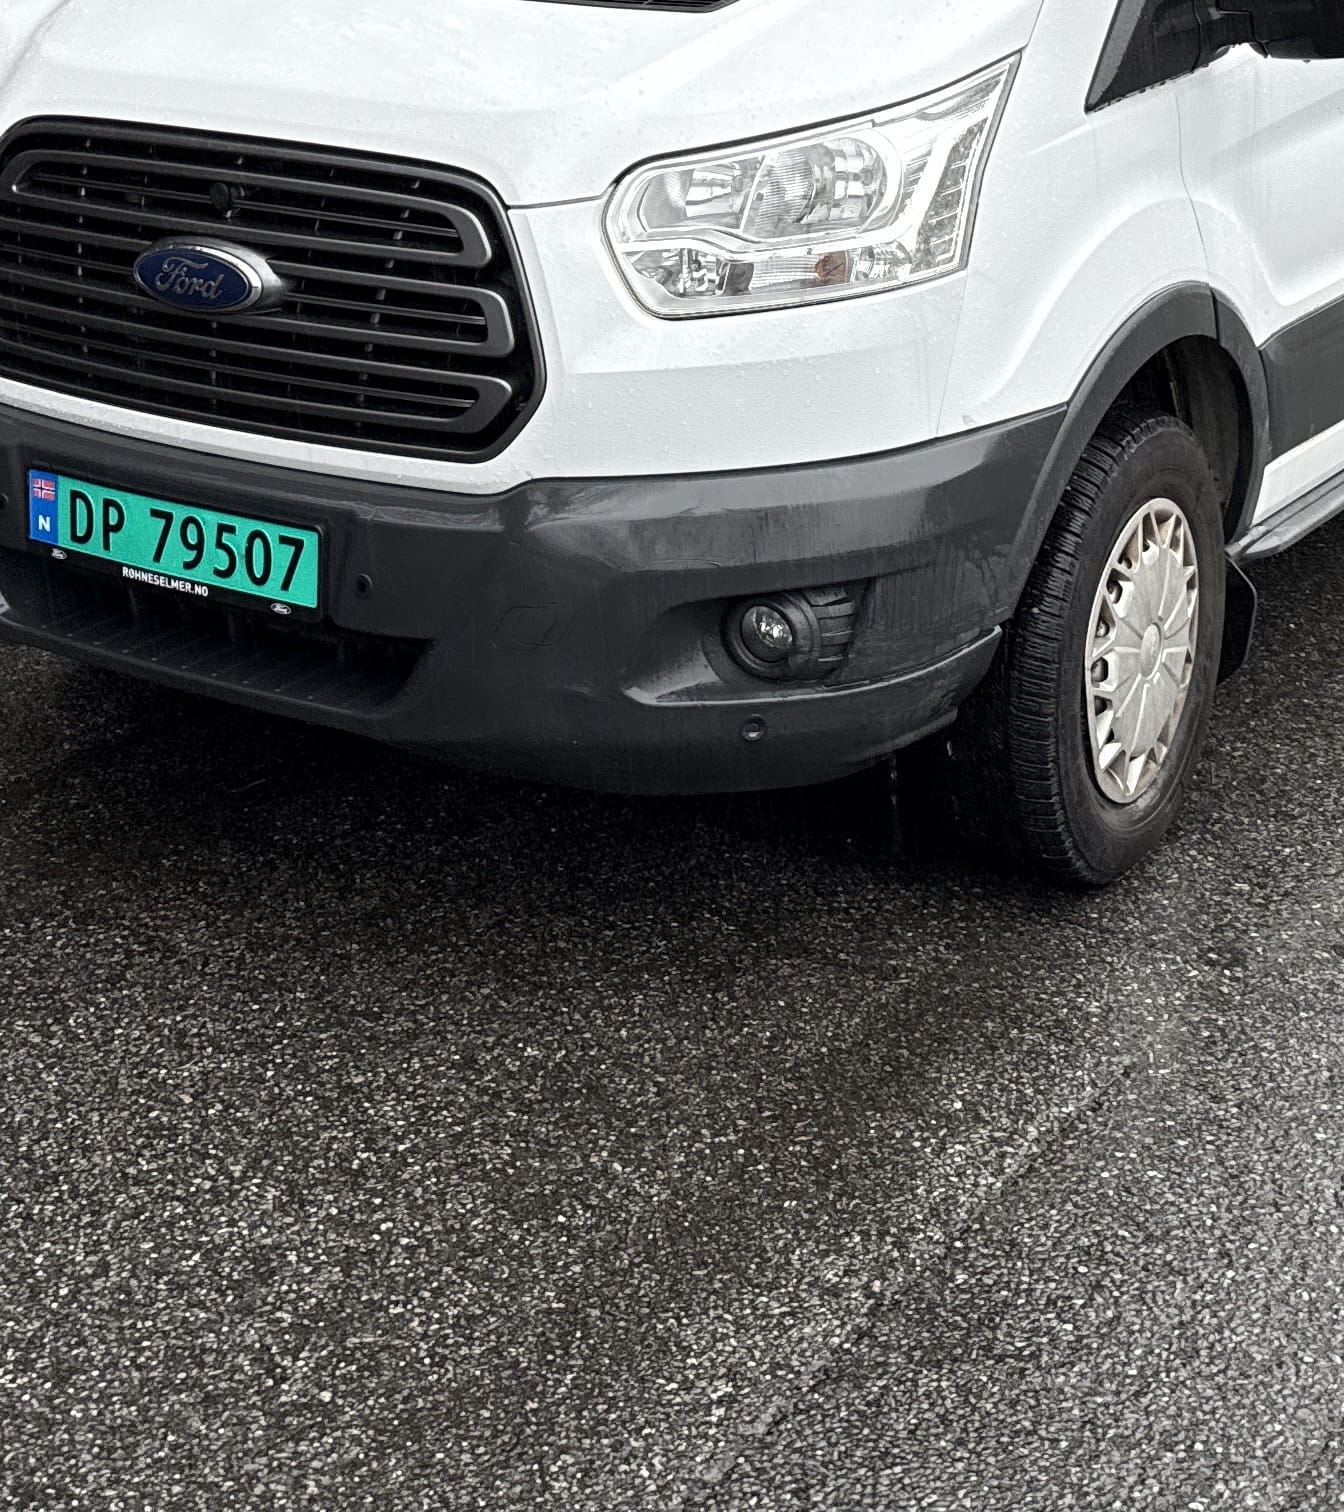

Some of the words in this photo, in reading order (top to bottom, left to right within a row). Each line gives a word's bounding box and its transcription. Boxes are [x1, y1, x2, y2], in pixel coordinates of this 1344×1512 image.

[156, 256, 225, 300] Ford
[38, 514, 51, 533] N
[69, 488, 125, 552] DP
[149, 509, 306, 593] 79507
